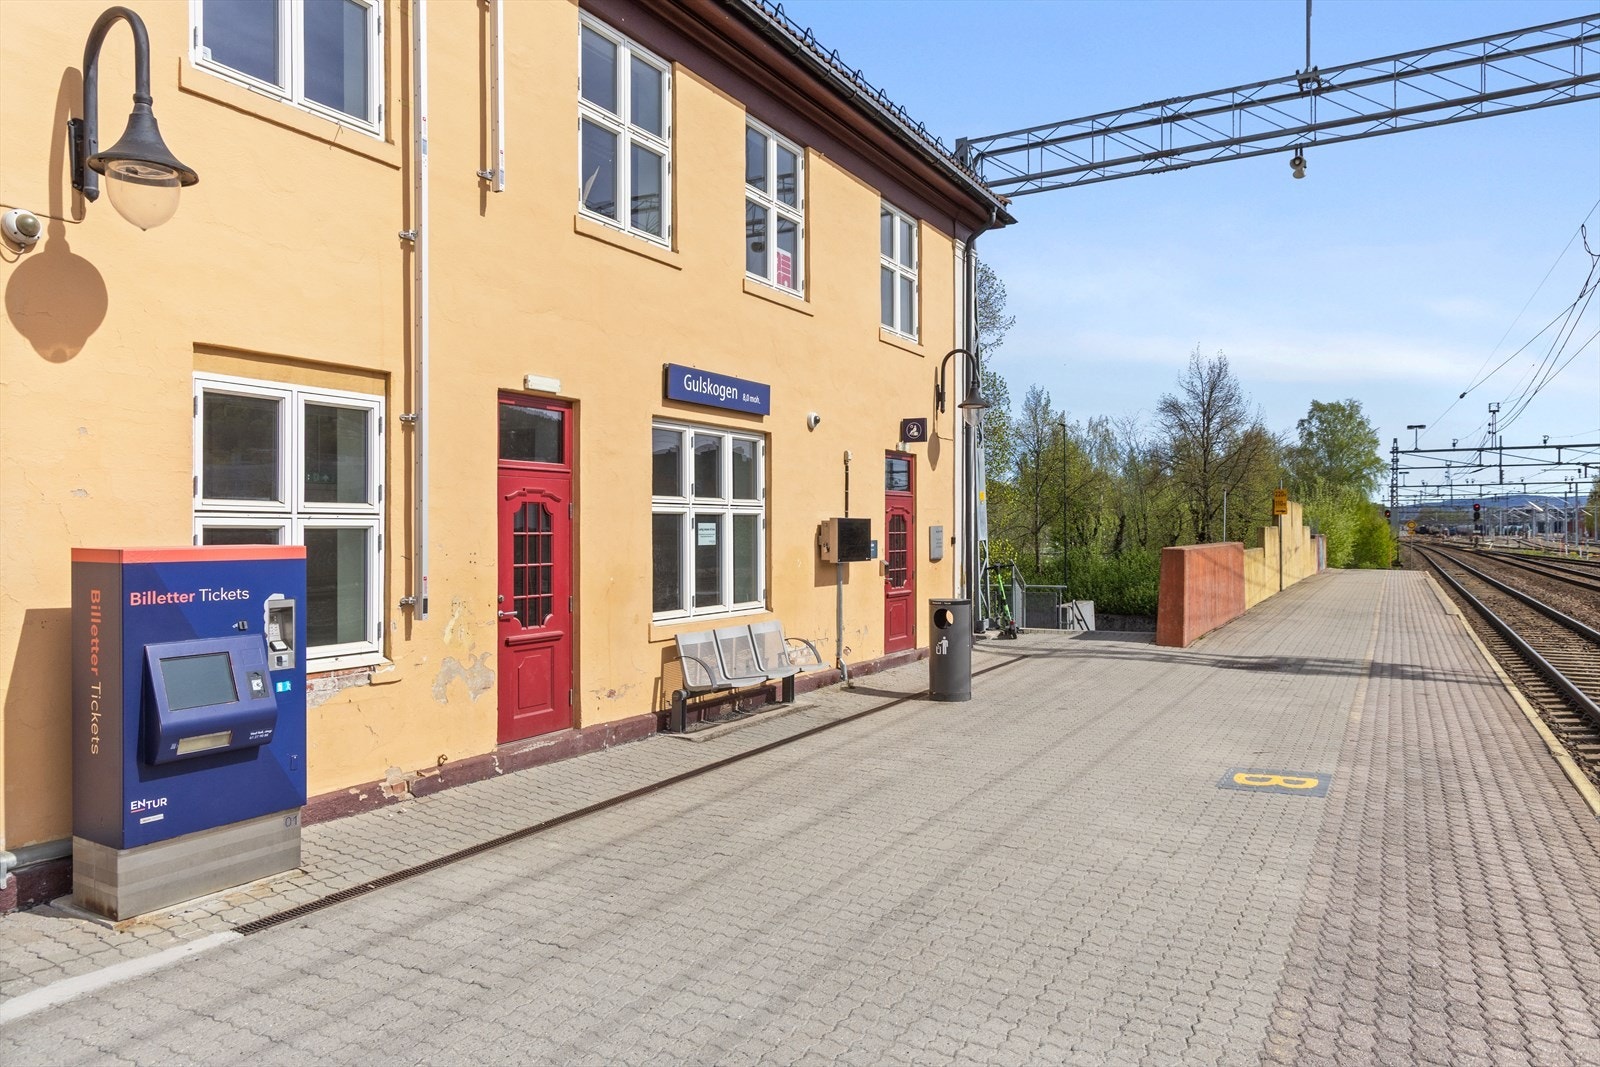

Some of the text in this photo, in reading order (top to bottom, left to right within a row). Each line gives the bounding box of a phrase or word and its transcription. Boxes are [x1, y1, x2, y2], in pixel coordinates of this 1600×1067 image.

[684, 374, 738, 400] Gulskogen
[130, 587, 250, 606] Billetter Tickets
[90, 589, 102, 755] Billetter Tickets
[1233, 772, 1319, 789] B
[130, 797, 168, 812] ENTUR
[285, 815, 298, 828] 01
